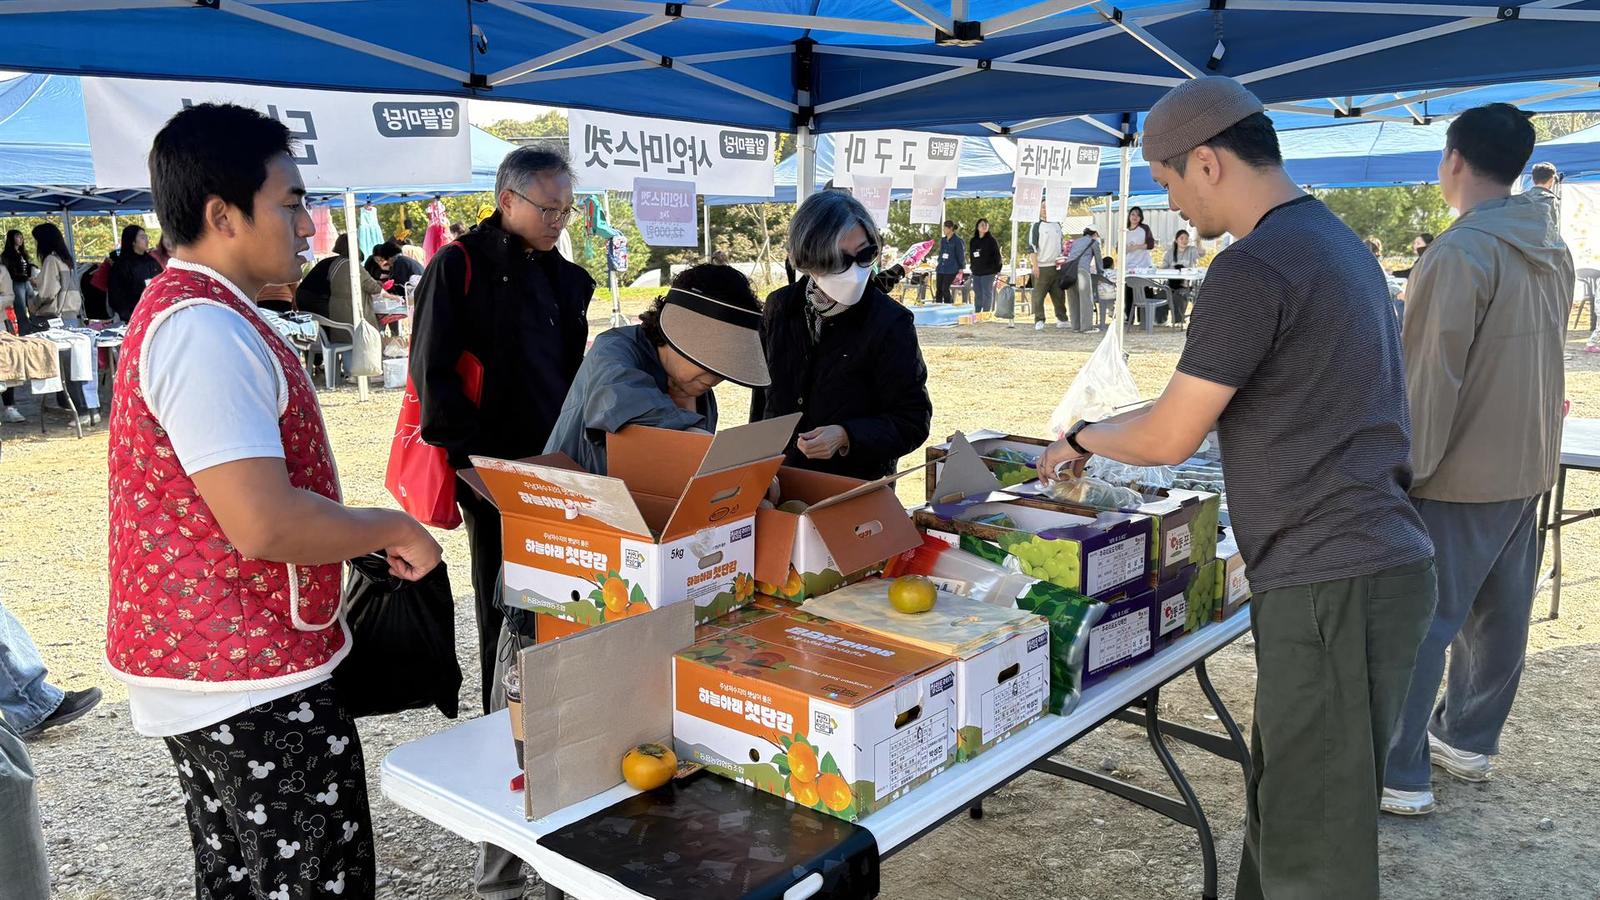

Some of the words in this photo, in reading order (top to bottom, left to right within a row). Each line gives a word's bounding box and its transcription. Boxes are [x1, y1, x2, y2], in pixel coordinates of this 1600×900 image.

[518, 491, 564, 510] 하늘아래
[525, 538, 565, 560] 하늘아래
[565, 545, 608, 572] 첫단감
[670, 547, 685, 560] 5kg
[686, 569, 713, 587] 하늘아래
[712, 559, 738, 580] 첫단감
[698, 687, 743, 715] 하늘아래
[744, 699, 794, 735] 첫단감
